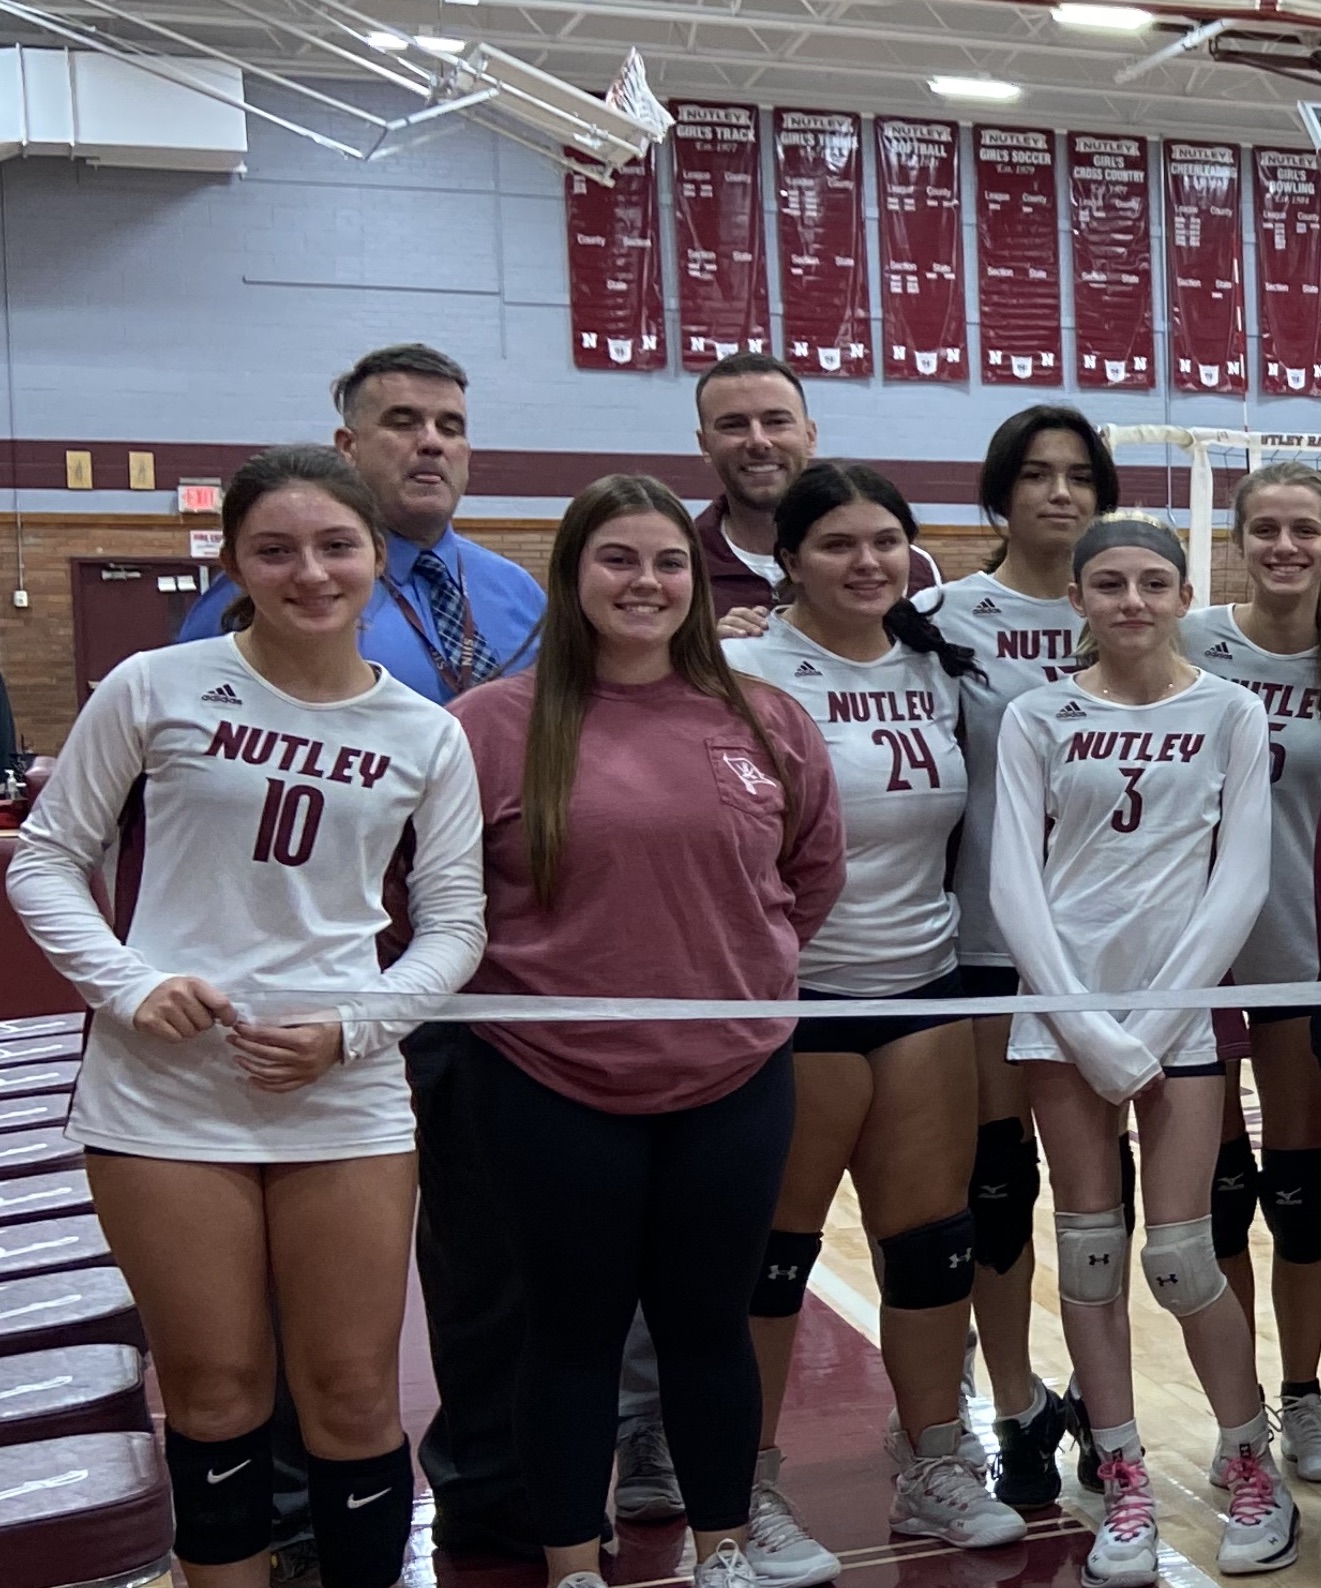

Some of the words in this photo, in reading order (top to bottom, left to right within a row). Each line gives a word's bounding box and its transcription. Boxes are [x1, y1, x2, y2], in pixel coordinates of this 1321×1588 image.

[686, 108, 742, 123] NUTLEY
[790, 117, 846, 129] NUTLEY
[716, 126, 756, 142] TRACK
[891, 126, 944, 140] NUTLEY
[988, 134, 1040, 146] NUTLEY
[1083, 141, 1134, 154] NUTLEY
[1178, 149, 1227, 161] NUTLEY
[1011, 150, 1051, 165] SOCCER
[1267, 155, 1314, 166] NUTLEY
[1073, 166, 1103, 181] CROSS
[1104, 169, 1145, 183] COUNTRY
[1269, 181, 1315, 195] BOWLING
[1210, 204, 1233, 218] County
[1297, 211, 1320, 223] County
[581, 332, 597, 349] N
[643, 334, 658, 350] N
[690, 336, 706, 352] N
[748, 338, 763, 354] N
[794, 341, 809, 358] N
[850, 342, 864, 359] N
[893, 345, 906, 361] N
[947, 347, 961, 363] N
[989, 350, 1002, 366] N
[1042, 352, 1055, 367] N
[1083, 354, 1097, 369] N
[1134, 356, 1148, 371] N
[1179, 358, 1192, 373] N
[1227, 361, 1241, 375] N
[1268, 361, 1279, 376] N
[1261, 434, 1302, 447] UTLEY
[996, 629, 1073, 660] NUTL
[828, 690, 935, 723] NUTLEY
[203, 719, 392, 788] NUTLEY
[1065, 731, 1206, 764] NUTLEY
[870, 727, 941, 793] 24
[1110, 767, 1146, 834] 3
[252, 776, 325, 868] 10
